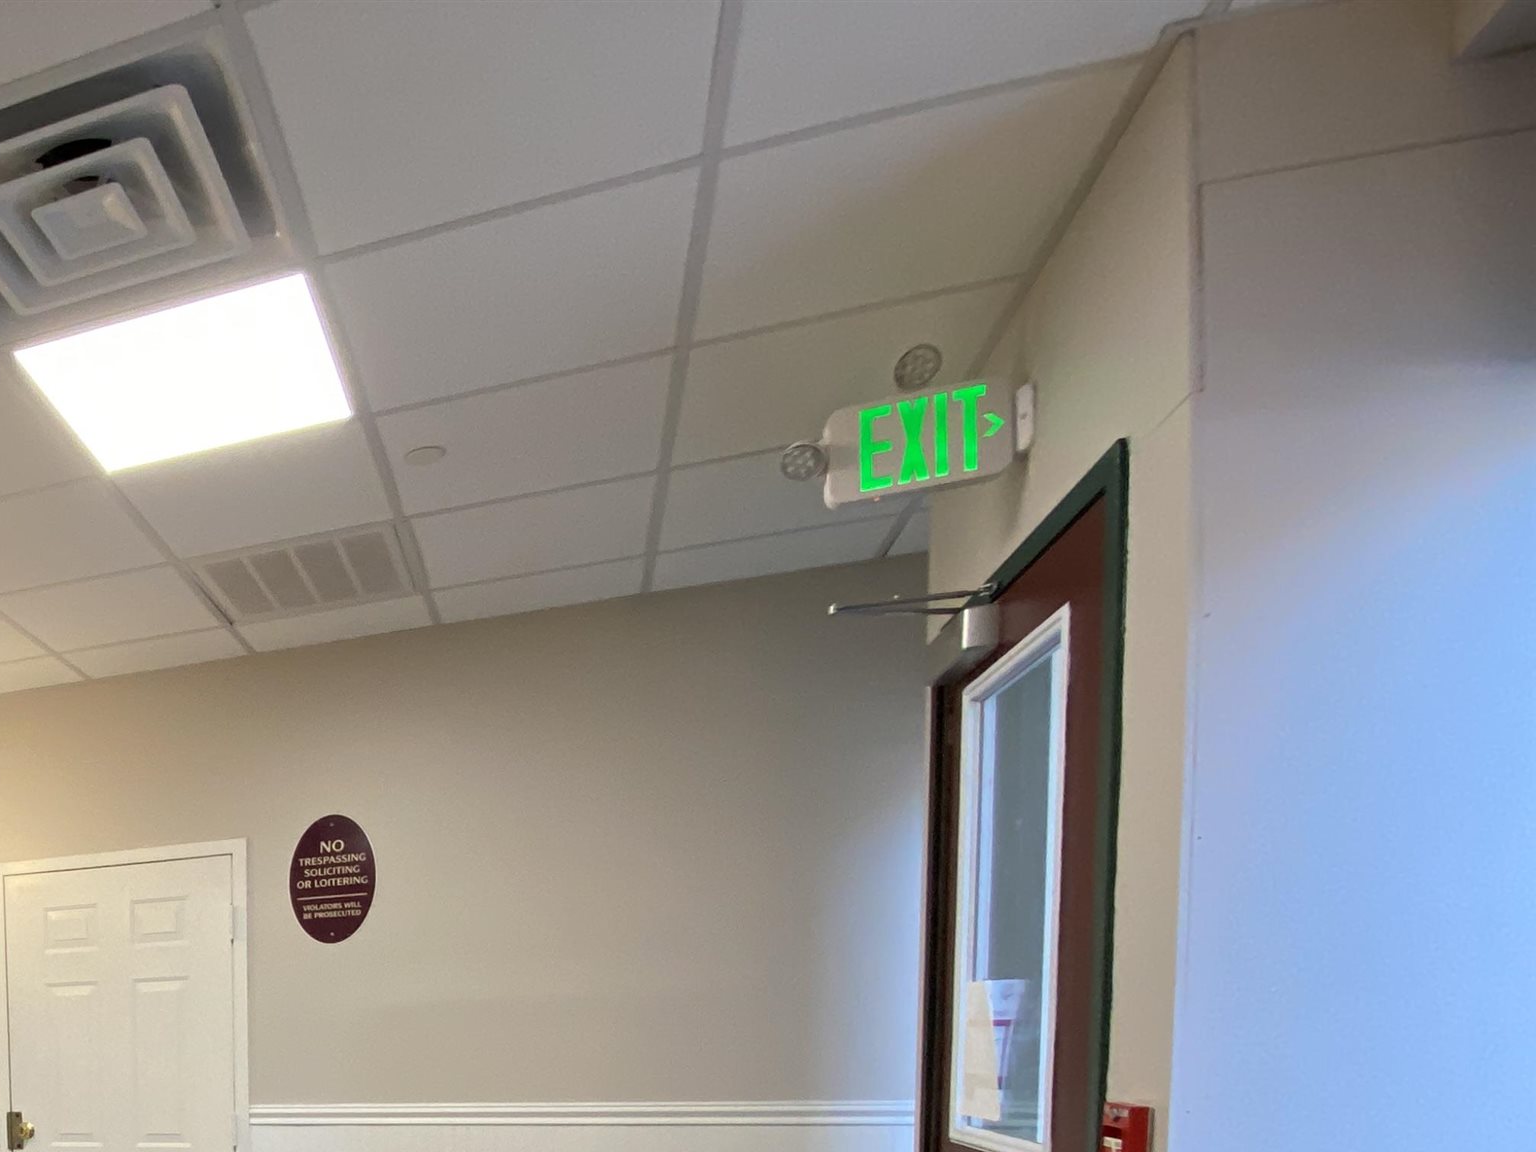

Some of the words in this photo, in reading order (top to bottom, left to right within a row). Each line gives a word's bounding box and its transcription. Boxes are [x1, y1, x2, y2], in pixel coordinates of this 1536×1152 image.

[859, 384, 987, 492] EXIT
[320, 840, 344, 853] NO
[299, 853, 367, 866] TRESPASSING
[304, 865, 360, 877] SOLICITING
[297, 881, 311, 889] OR
[314, 876, 368, 888] LOITERING
[314, 909, 361, 918] PROSECUTED
